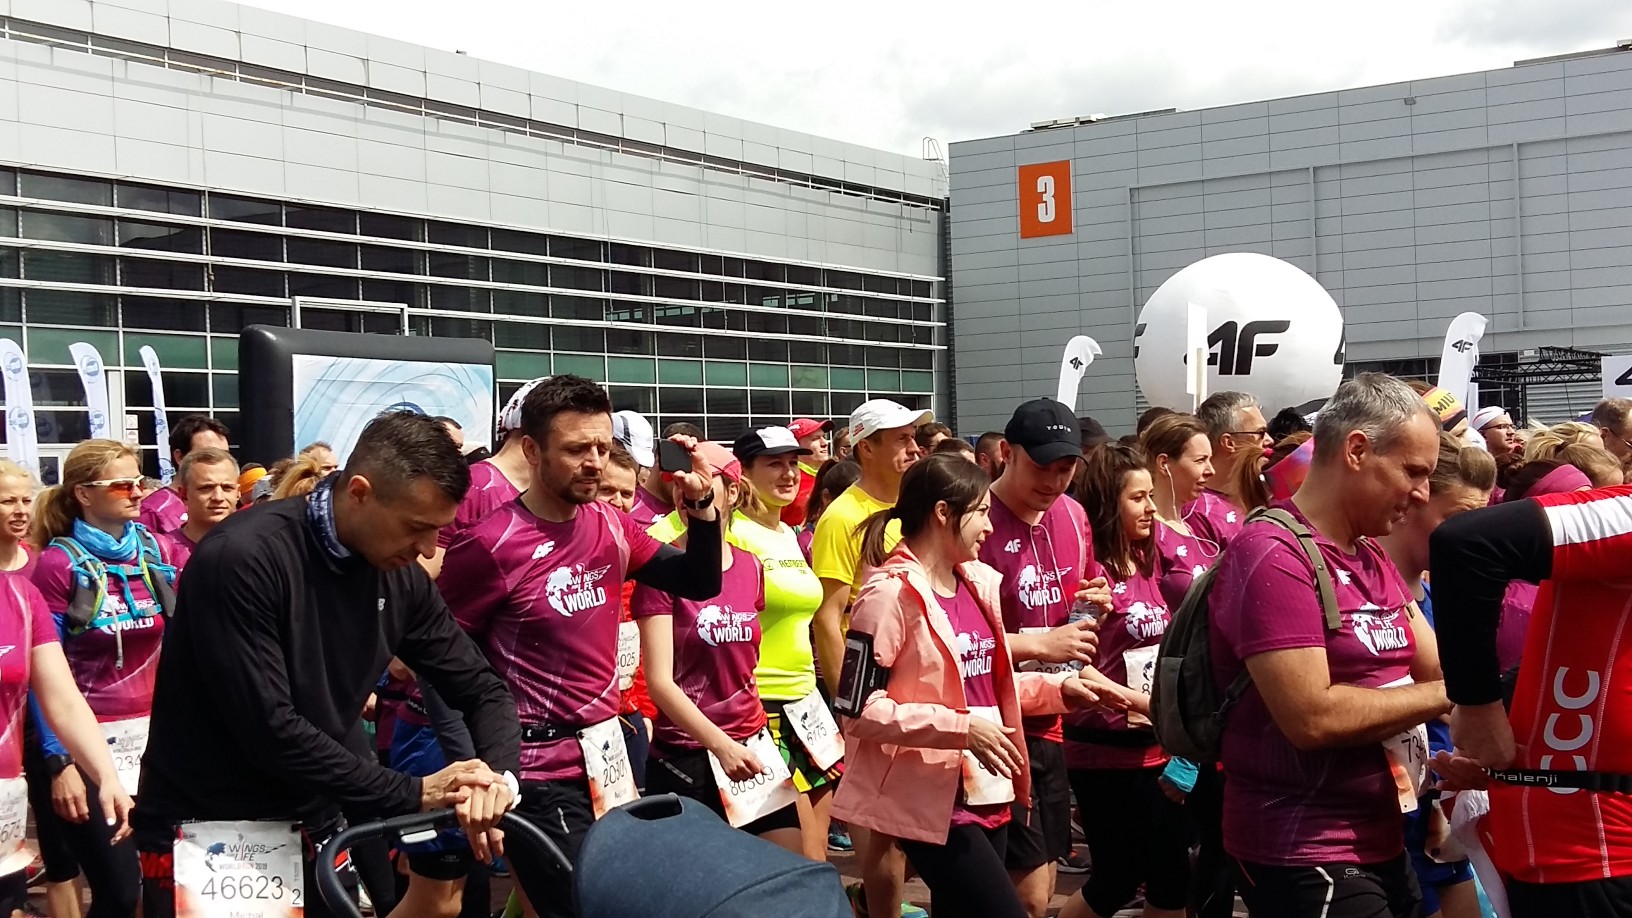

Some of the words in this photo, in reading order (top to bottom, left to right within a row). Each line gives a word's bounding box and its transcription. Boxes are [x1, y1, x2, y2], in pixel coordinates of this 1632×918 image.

[1037, 175, 1056, 223] 3
[563, 586, 607, 614] WORLD
[712, 625, 753, 643] WORLD
[1369, 626, 1409, 651] WORLD
[961, 655, 993, 678] WORLD
[1494, 772, 1558, 786] Kalenji
[229, 842, 266, 854] WINGS
[201, 875, 284, 900] 46623
[292, 888, 301, 905] 2
